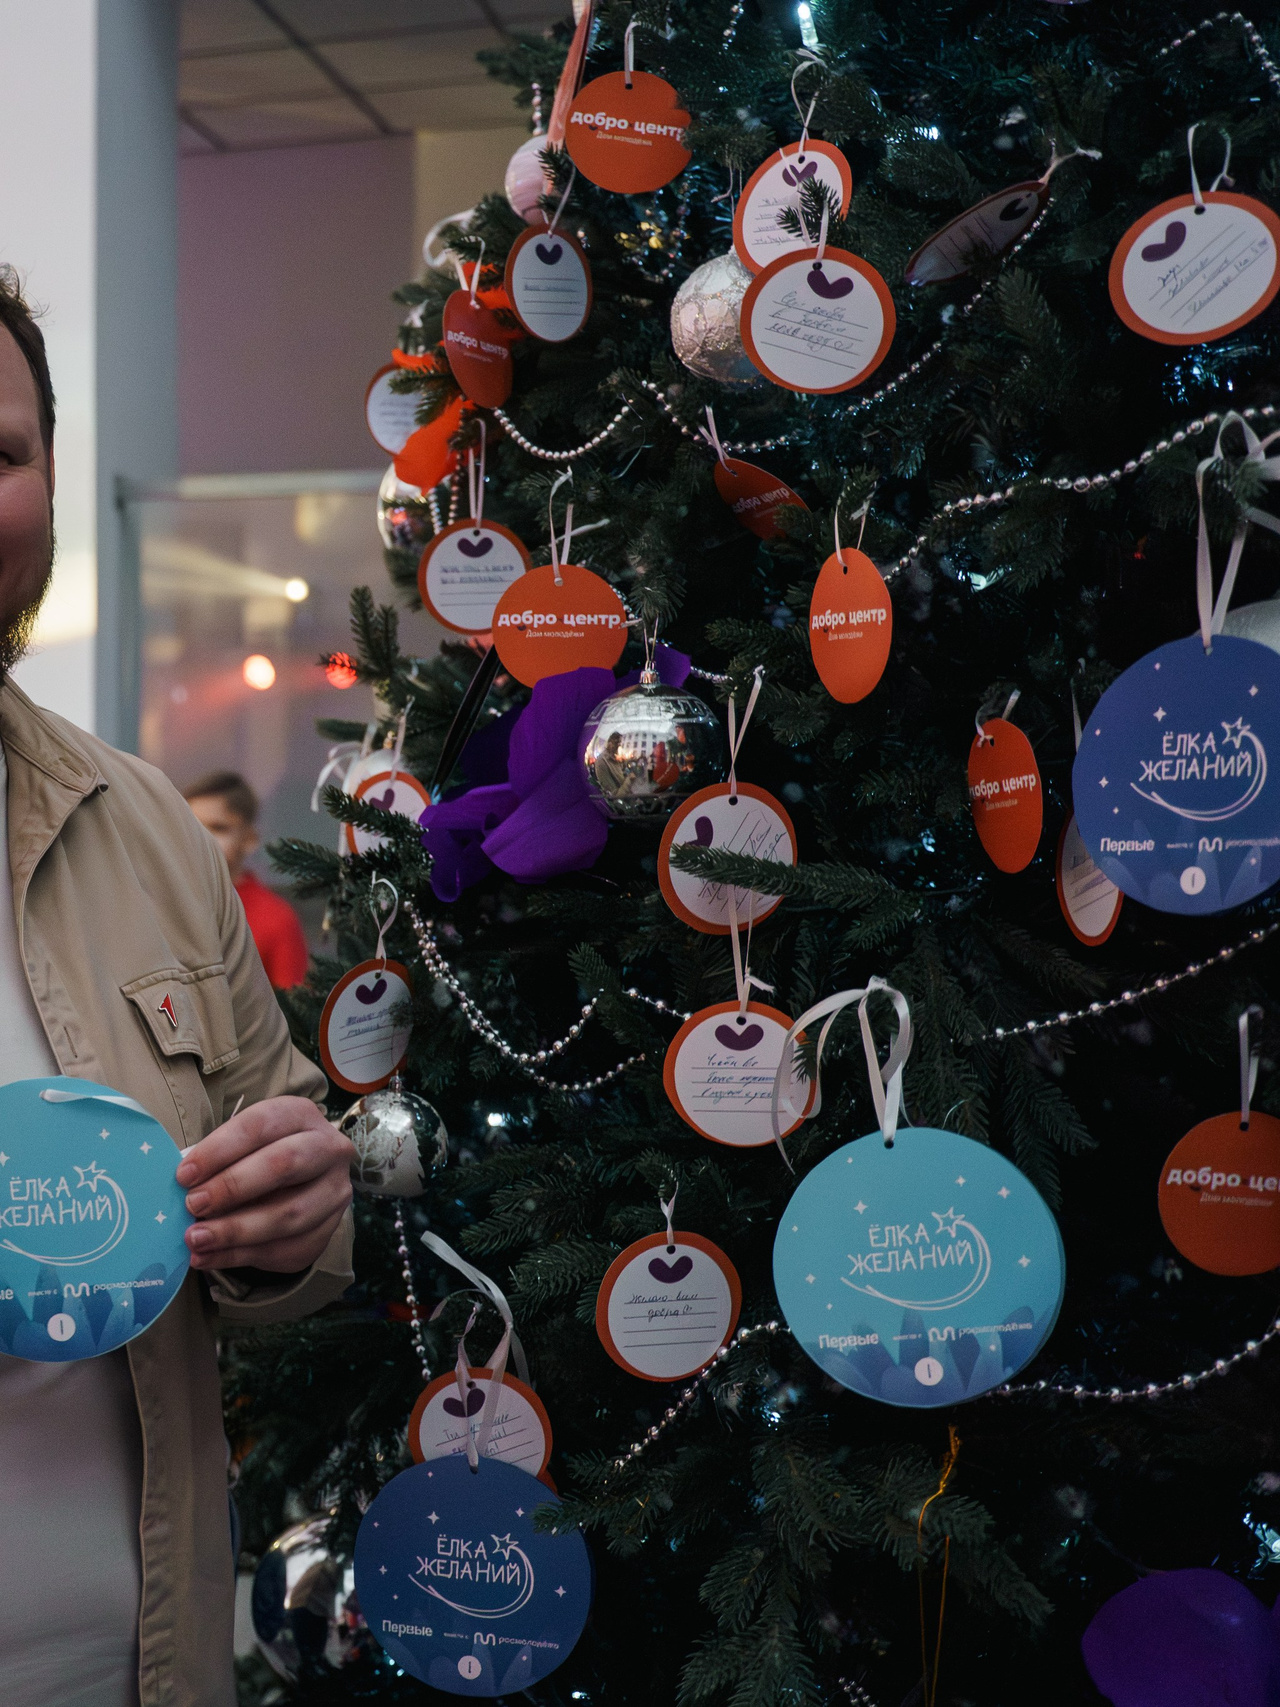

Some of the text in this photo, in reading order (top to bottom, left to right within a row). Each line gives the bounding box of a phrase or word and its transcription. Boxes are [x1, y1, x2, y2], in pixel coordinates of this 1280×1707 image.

[570, 111, 629, 130] добро
[447, 330, 478, 348] добро
[497, 610, 621, 629] добро центр
[811, 608, 887, 630] добро центр
[1162, 731, 1216, 756] ЁЛКА
[1138, 751, 1252, 782] ЖЕЛАНИЙ
[1002, 773, 1036, 794] центр
[1100, 837, 1155, 855] Первые
[9, 1176, 72, 1201] ЁЛКА
[1166, 1166, 1280, 1192] добро це
[868, 1223, 930, 1248] ЁЛКА
[847, 1240, 974, 1275] ЖЕЛАНИЙ
[818, 1333, 879, 1351] Первые
[437, 1534, 487, 1560] ЁЛКА
[415, 1555, 520, 1586] ЖЕЛАНИЙ
[382, 1619, 433, 1637] Первые
